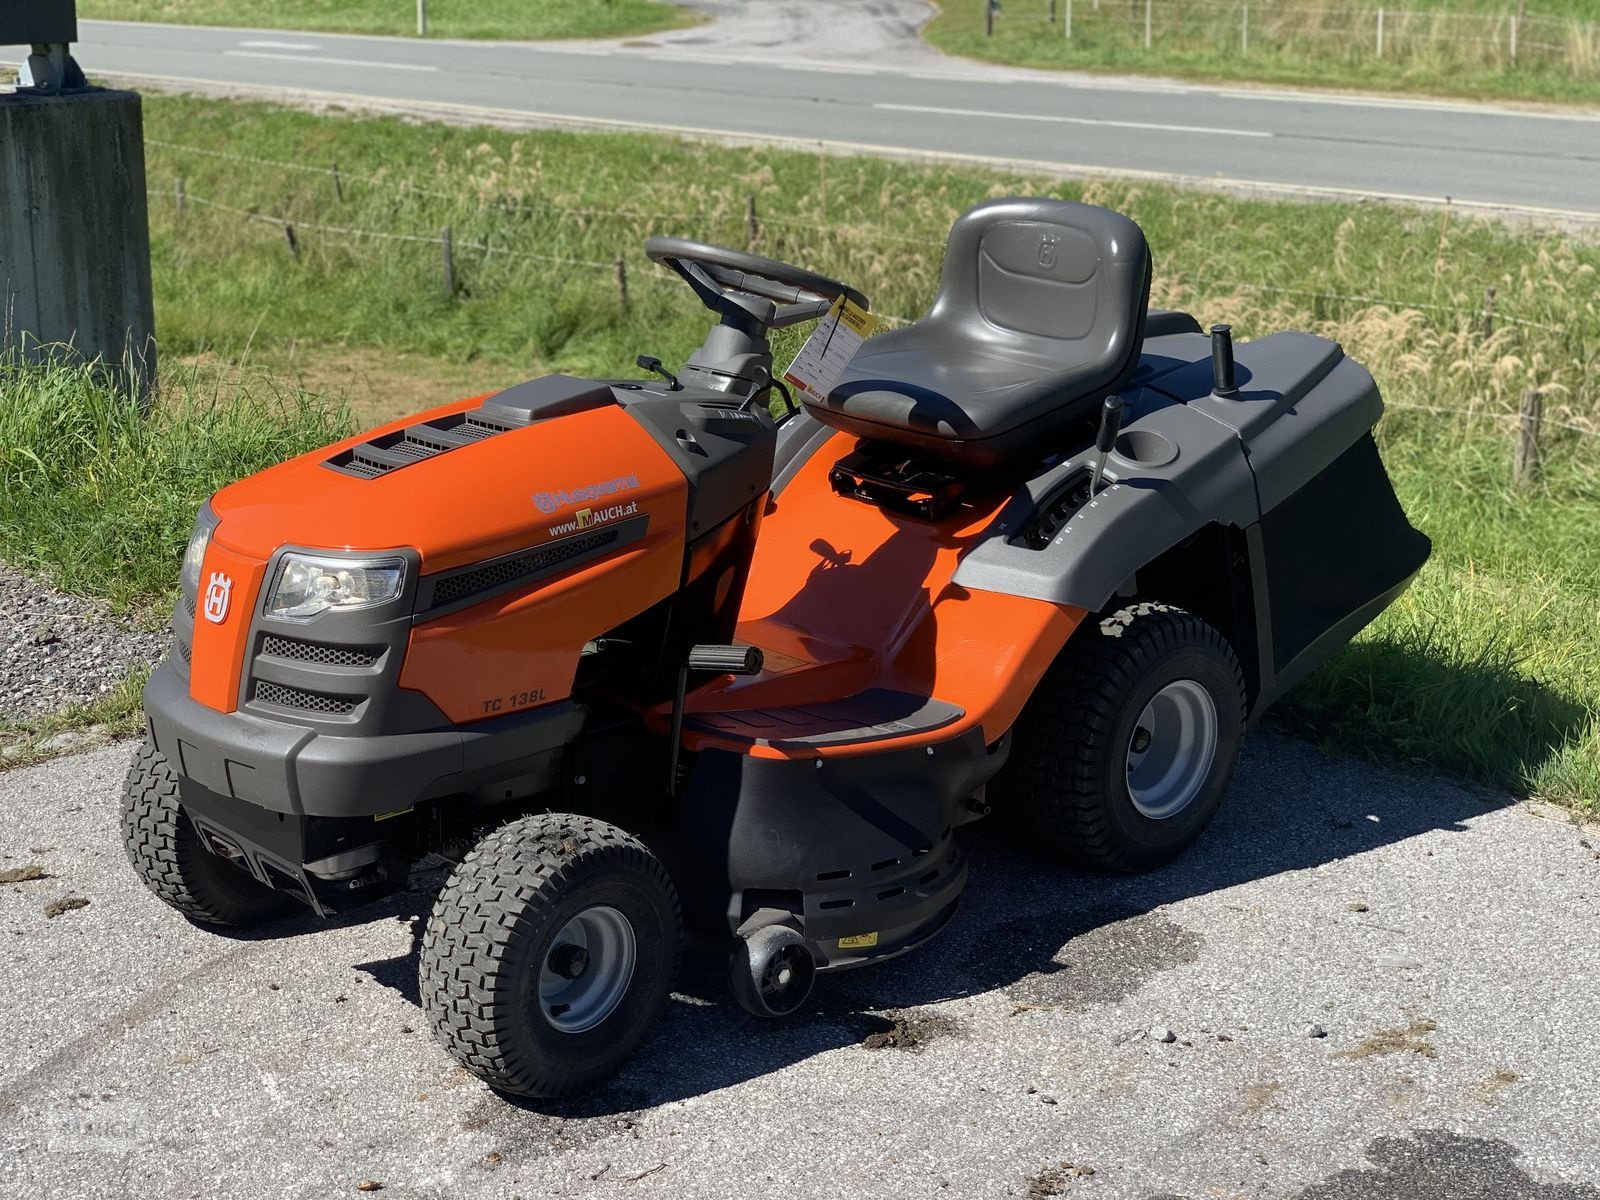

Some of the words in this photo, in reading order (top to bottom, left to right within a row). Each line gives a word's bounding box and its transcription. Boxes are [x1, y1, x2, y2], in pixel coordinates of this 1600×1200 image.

[552, 475, 639, 506] Husqvarna
[549, 501, 637, 536] www.MAUCH.at
[483, 699, 502, 713] TC
[510, 688, 546, 707] 138L
